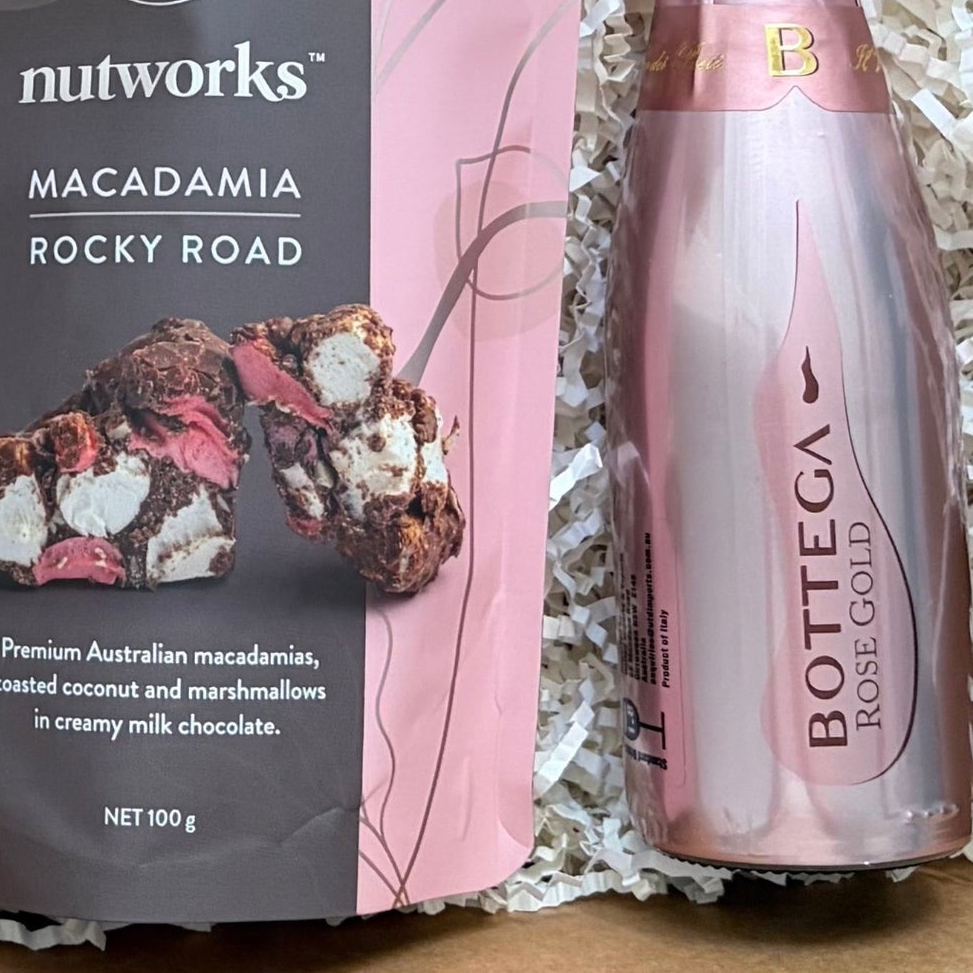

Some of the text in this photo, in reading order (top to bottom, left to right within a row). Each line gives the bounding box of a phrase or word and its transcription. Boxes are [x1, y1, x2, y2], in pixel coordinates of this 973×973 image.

[764, 23, 819, 77] B
[29, 167, 300, 198] MACADAMIA
[31, 235, 301, 265] ROCKY ROAD
[793, 423, 848, 747] BOTTEGA
[659, 609, 669, 633] Italy
[849, 522, 881, 730] ROSE GOLD
[3, 637, 319, 669] Premium Australian macadamias,
[661, 648, 670, 688] Product
[63, 682, 139, 698] coconut
[145, 678, 181, 699] and
[189, 679, 326, 699] marshmallows
[35, 708, 280, 740] in creamy milk chocolate.
[105, 807, 195, 833] NET 100 g
